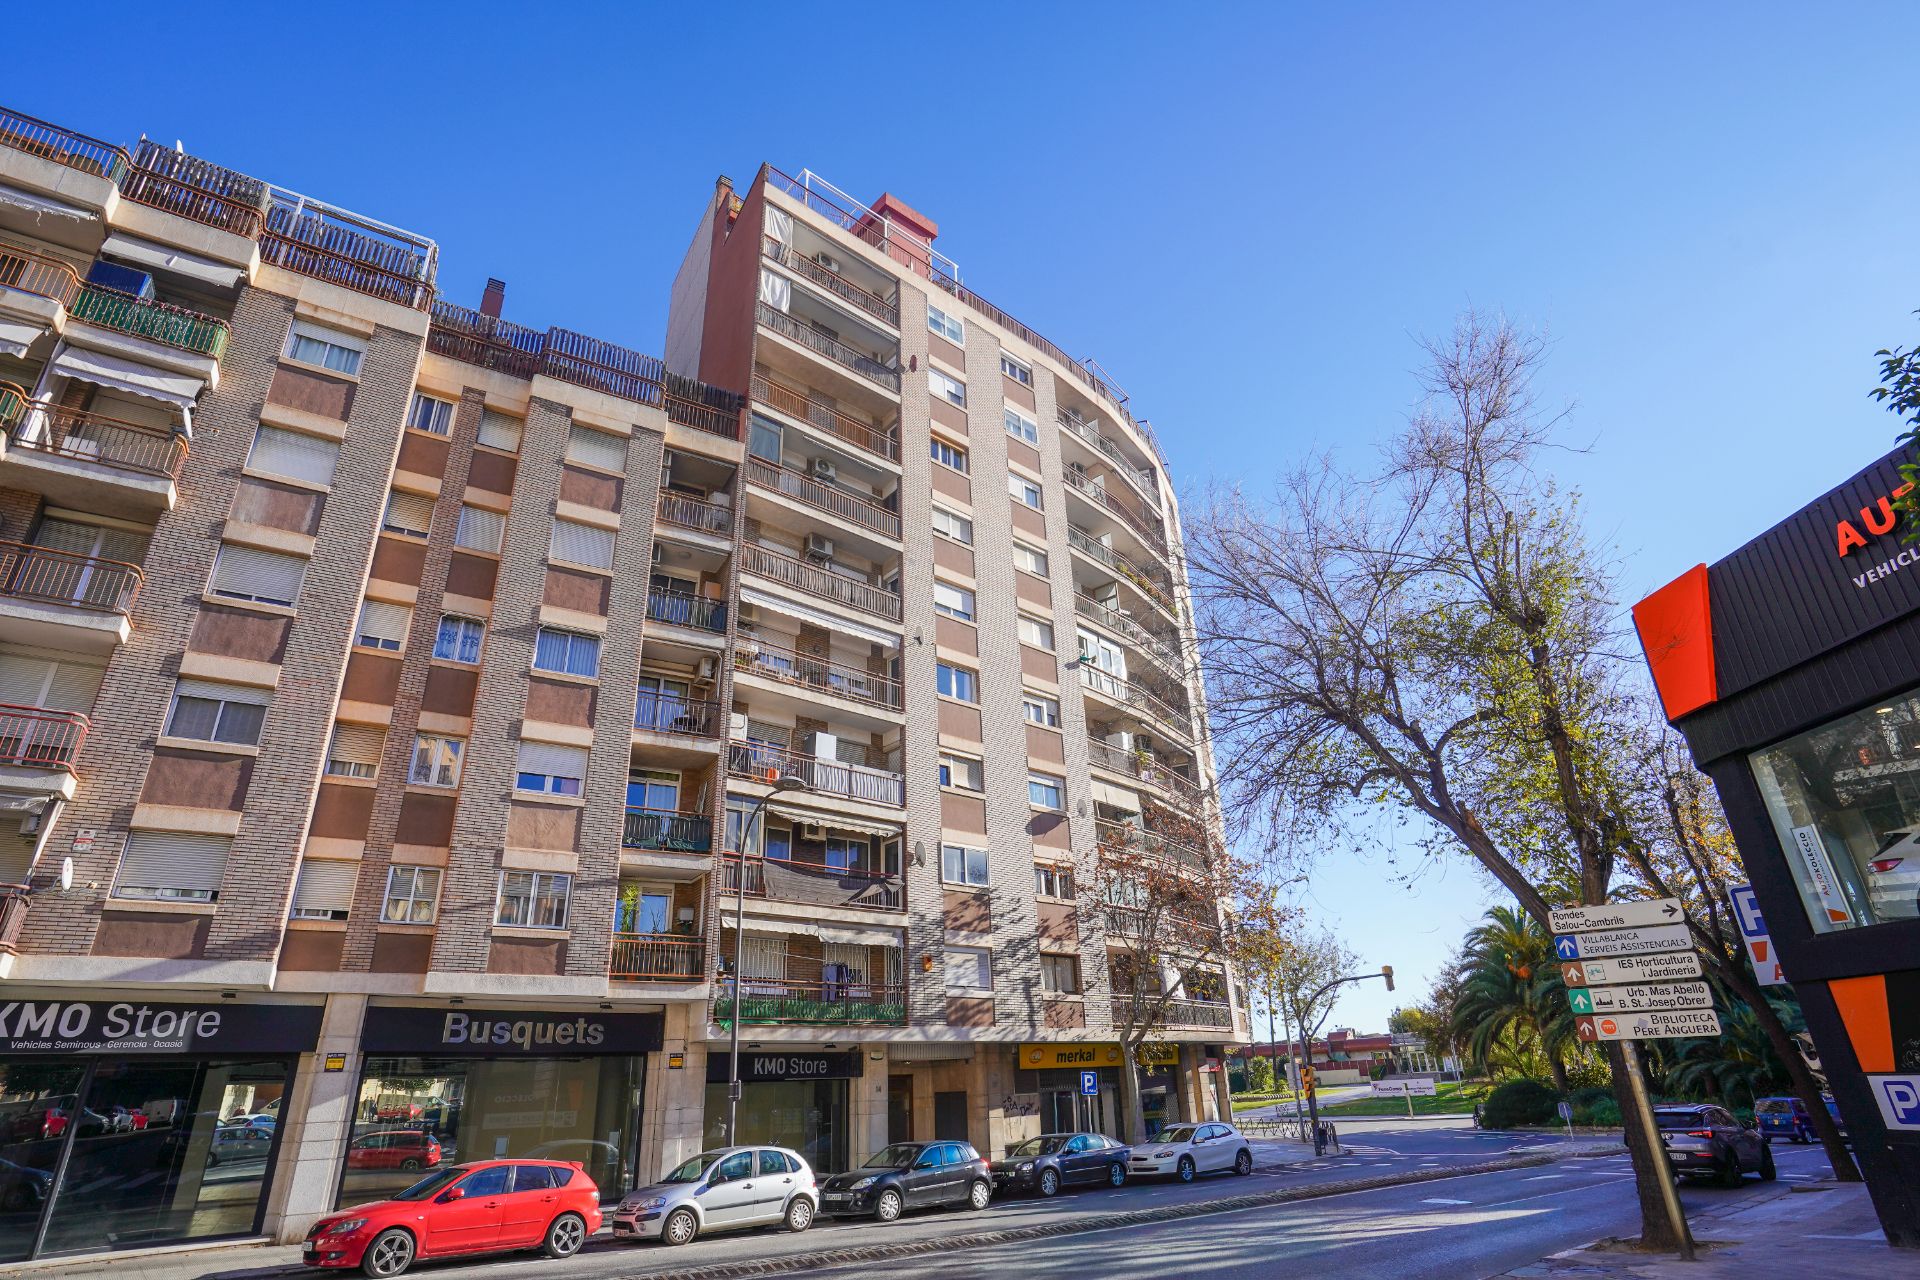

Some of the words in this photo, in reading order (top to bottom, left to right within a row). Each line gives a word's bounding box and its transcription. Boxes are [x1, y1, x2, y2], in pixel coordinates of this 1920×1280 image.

[1853, 543, 1920, 589] VEHICL
[1552, 911, 1585, 921] Rondes
[1555, 916, 1625, 931] Salou-Cambrils
[1581, 932, 1639, 944] VILLABLANCA
[1583, 944, 1618, 955] SERVEIS
[1620, 938, 1687, 952] ASSISTENCIALS
[1618, 958, 1634, 969] IES
[1636, 954, 1693, 968] Horticultura
[1647, 965, 1696, 978] Jardineria
[1626, 986, 1648, 997] Urb.
[1649, 986, 1671, 996] Mas
[1673, 983, 1705, 995] Abelló
[1619, 999, 1630, 1009] B.
[1647, 996, 1676, 1010] Josep
[1677, 995, 1706, 1006] Obrer
[102, 1003, 221, 1038] Store
[1651, 1013, 1715, 1025] BIBLIOTECA
[442, 1013, 605, 1051] Busquets
[1633, 1026, 1661, 1037] PERE
[1664, 1023, 1718, 1035] ANGUERA
[11, 1041, 52, 1049] Vehicles
[54, 1040, 101, 1049] Seminous
[107, 1040, 147, 1048] Gerencia
[153, 1040, 183, 1048] Ocasió
[1056, 1048, 1096, 1063] merkal
[790, 1057, 828, 1074] Store
[1084, 1074, 1094, 1093] P
[1886, 1084, 1918, 1119] P
